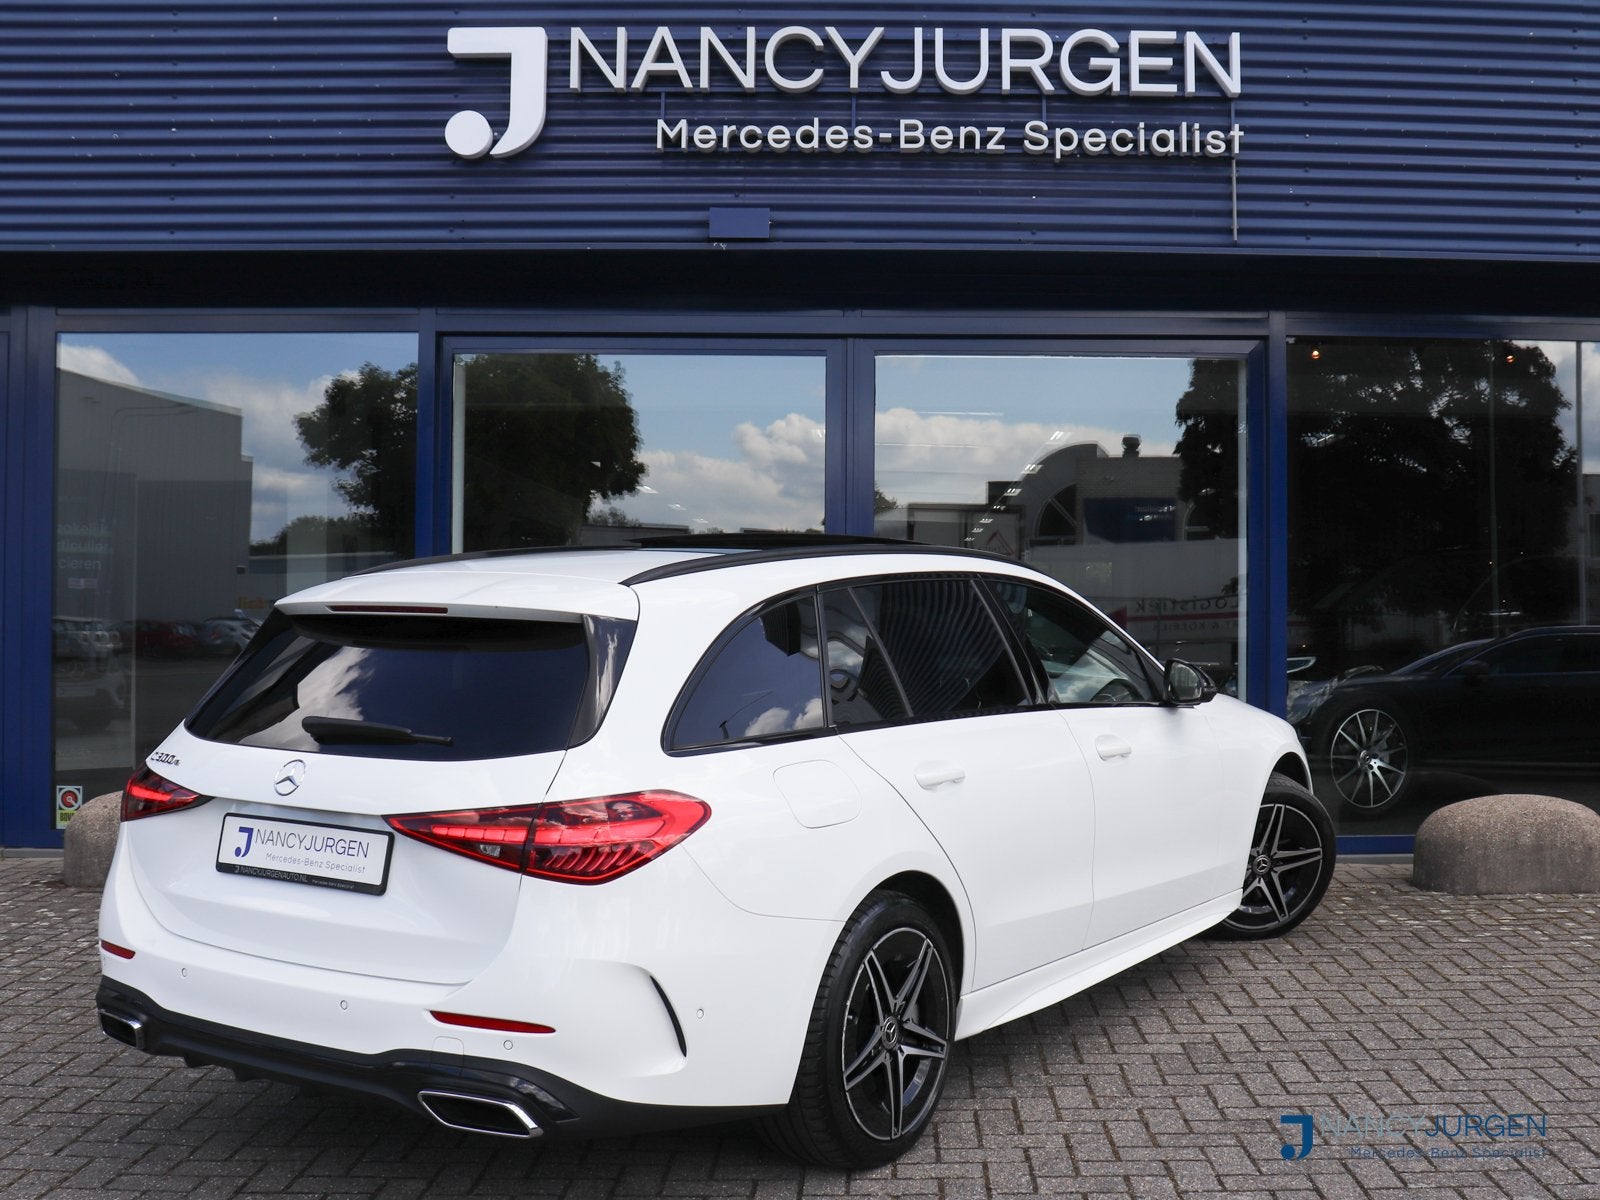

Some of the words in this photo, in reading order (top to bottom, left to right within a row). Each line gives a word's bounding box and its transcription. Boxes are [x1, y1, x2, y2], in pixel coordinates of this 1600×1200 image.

[569, 25, 1242, 98] NANCYJURGEN
[656, 117, 1006, 154] Mercedes-Benz
[1023, 120, 1244, 163] Specialist
[255, 828, 370, 858] NANCYJURGEN
[266, 852, 323, 868] Mercedes-Benz
[326, 861, 366, 874] Specialist
